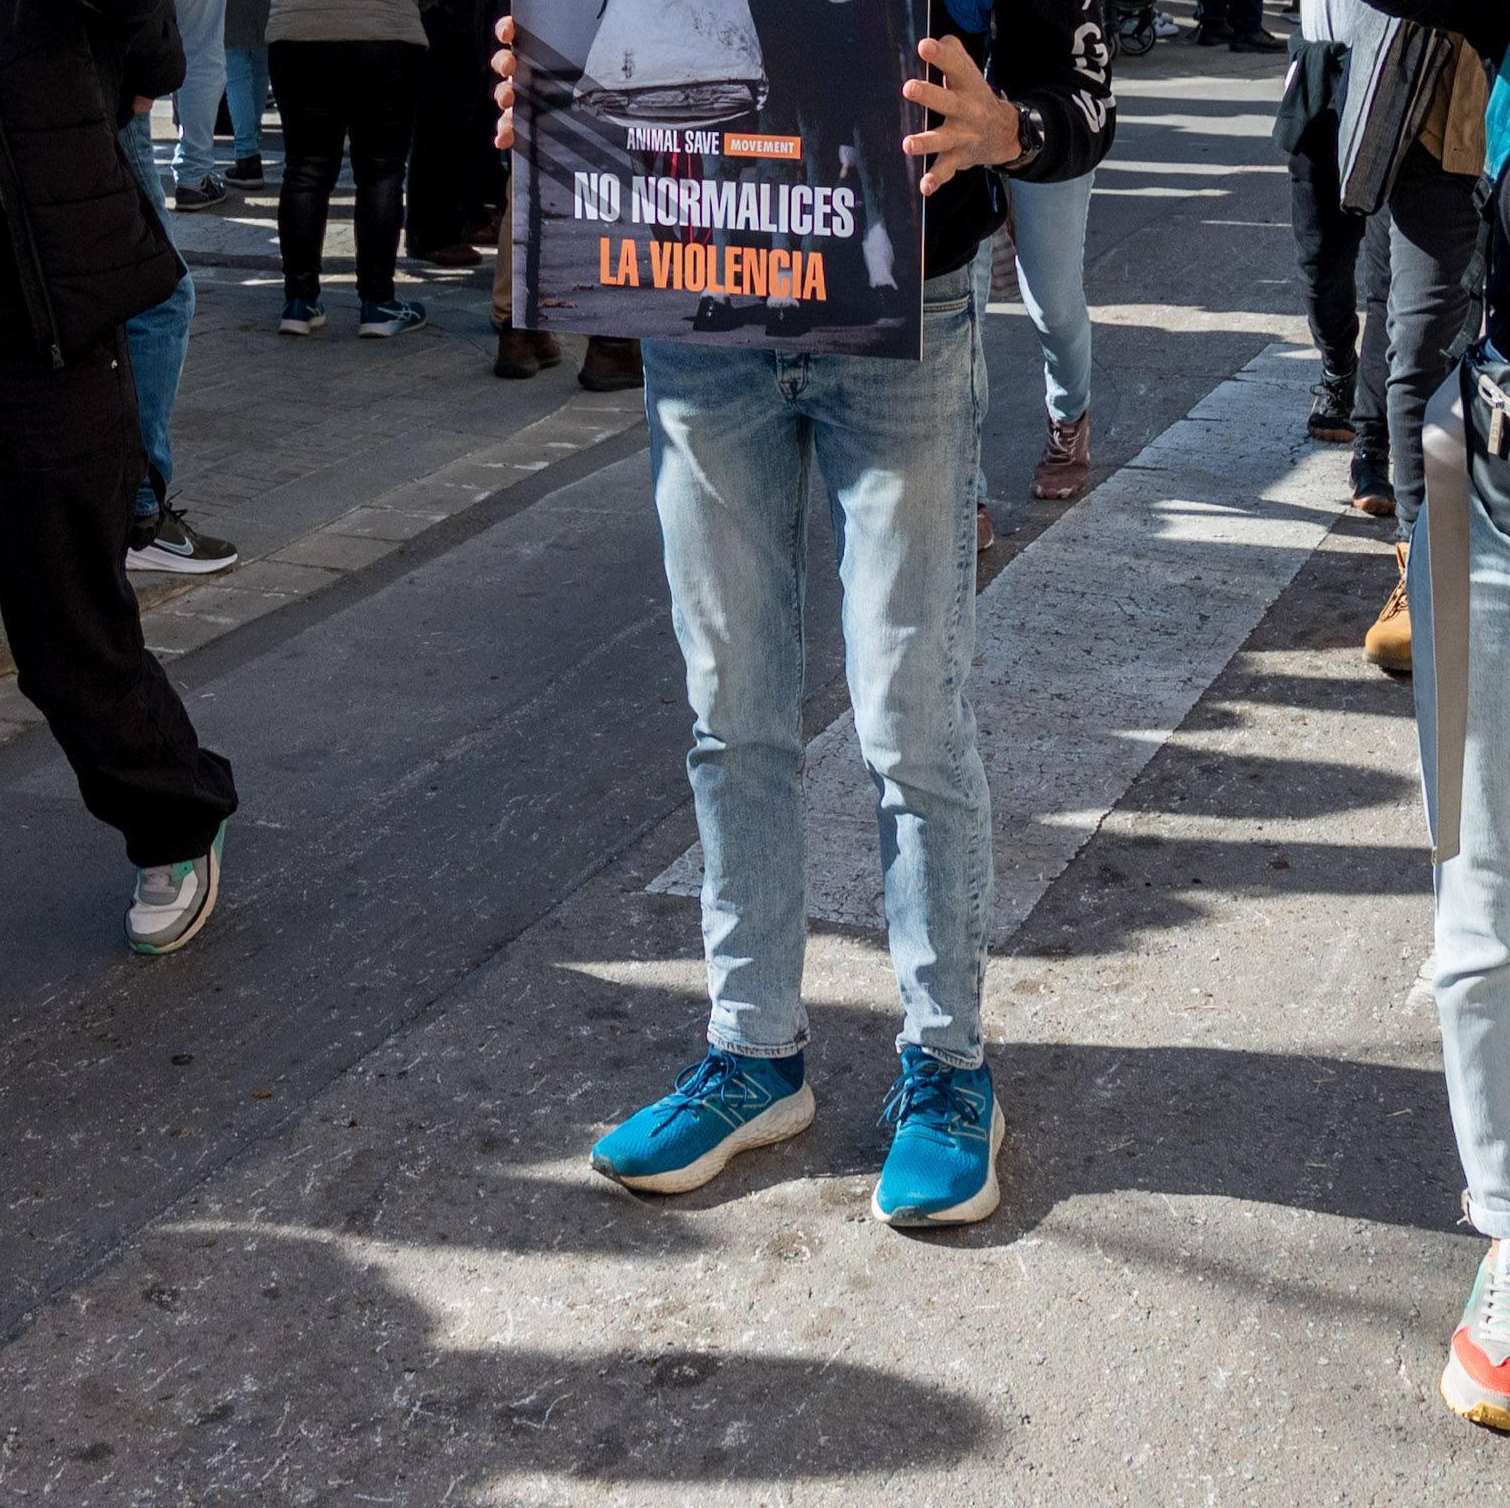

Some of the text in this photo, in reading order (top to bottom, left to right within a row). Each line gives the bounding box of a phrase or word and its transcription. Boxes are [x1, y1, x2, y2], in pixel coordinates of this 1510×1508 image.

[627, 128, 795, 156] ANIMAL SAVE MOVEMENT
[573, 172, 856, 238] NO NORMALICES
[599, 237, 828, 302] LA VIOLENCIA
